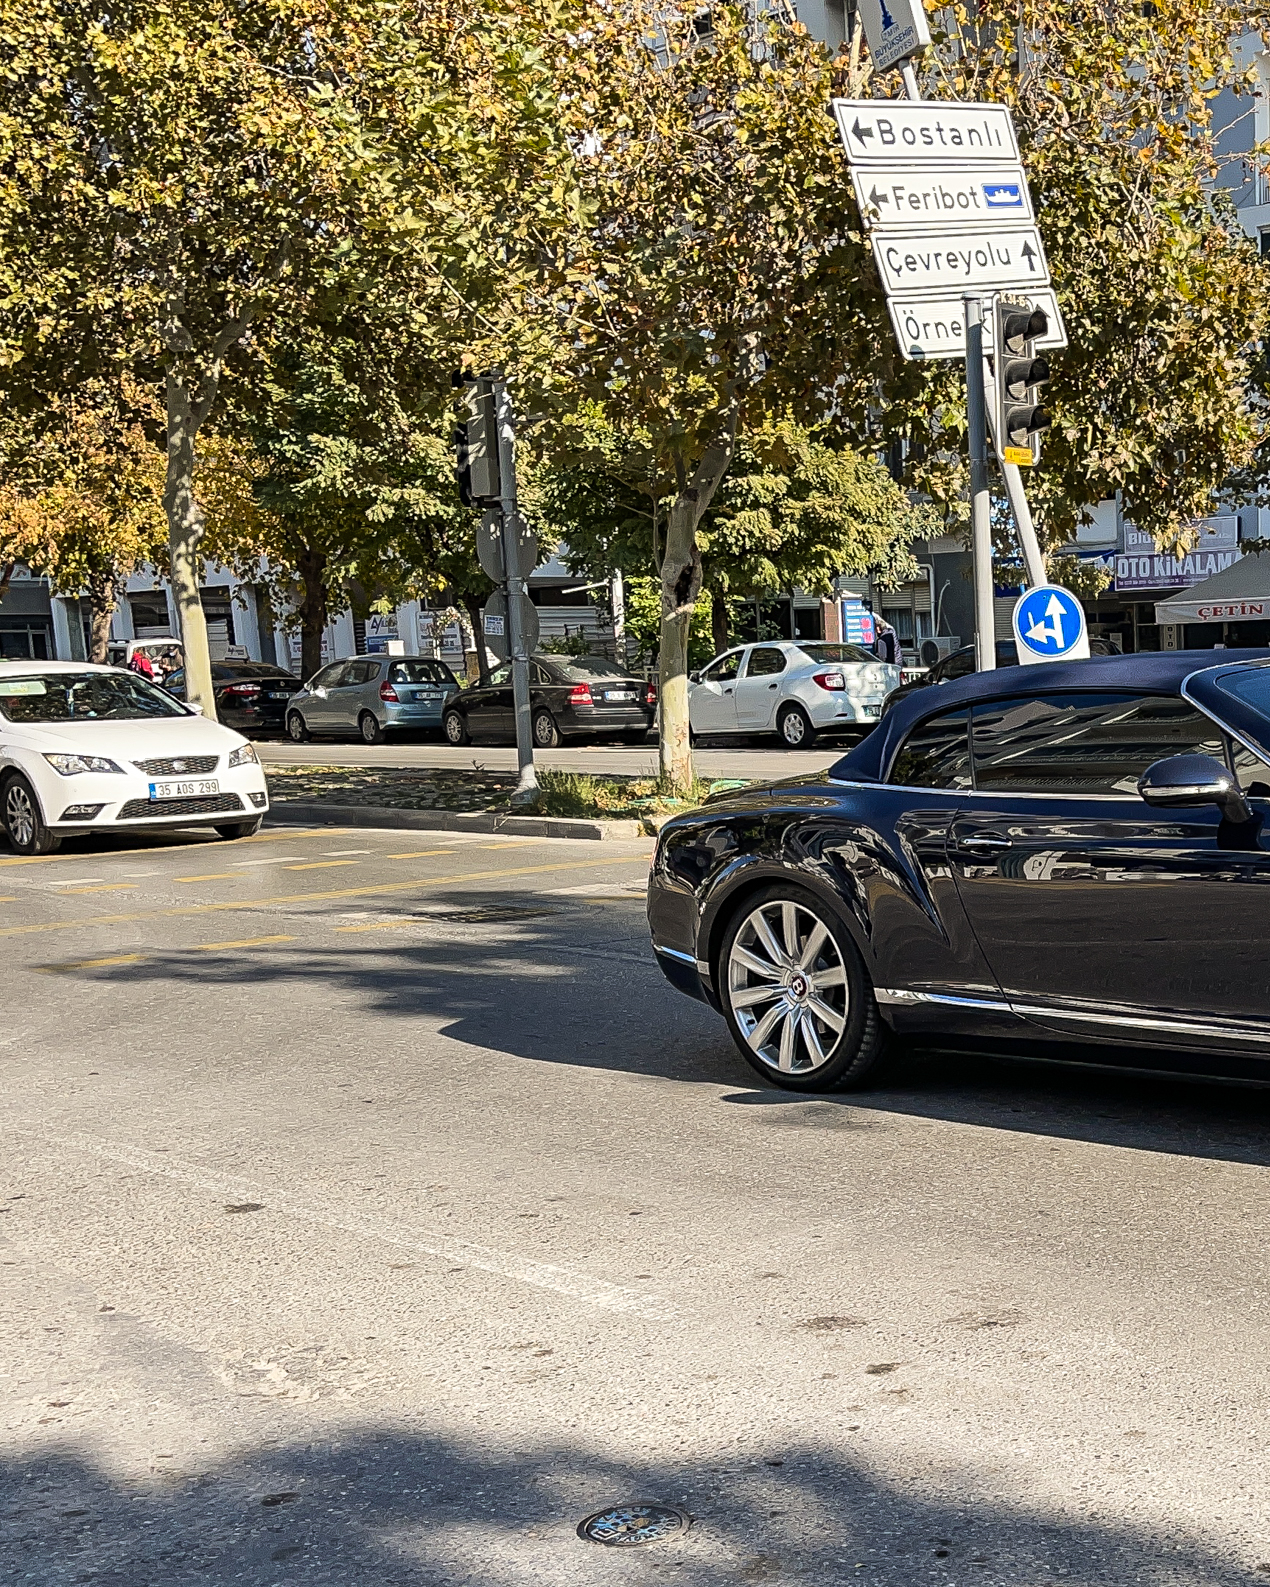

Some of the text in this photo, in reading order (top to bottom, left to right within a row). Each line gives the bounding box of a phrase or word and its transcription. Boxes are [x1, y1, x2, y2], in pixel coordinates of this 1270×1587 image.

[875, 118, 1002, 147] Bostanlı
[891, 186, 981, 211] Feribot
[886, 241, 1012, 278] Çevreyolu
[1117, 556, 1150, 579] OTO
[1197, 602, 1264, 620] ÇETİN
[158, 784, 171, 796] 35
[198, 781, 217, 794] 299
